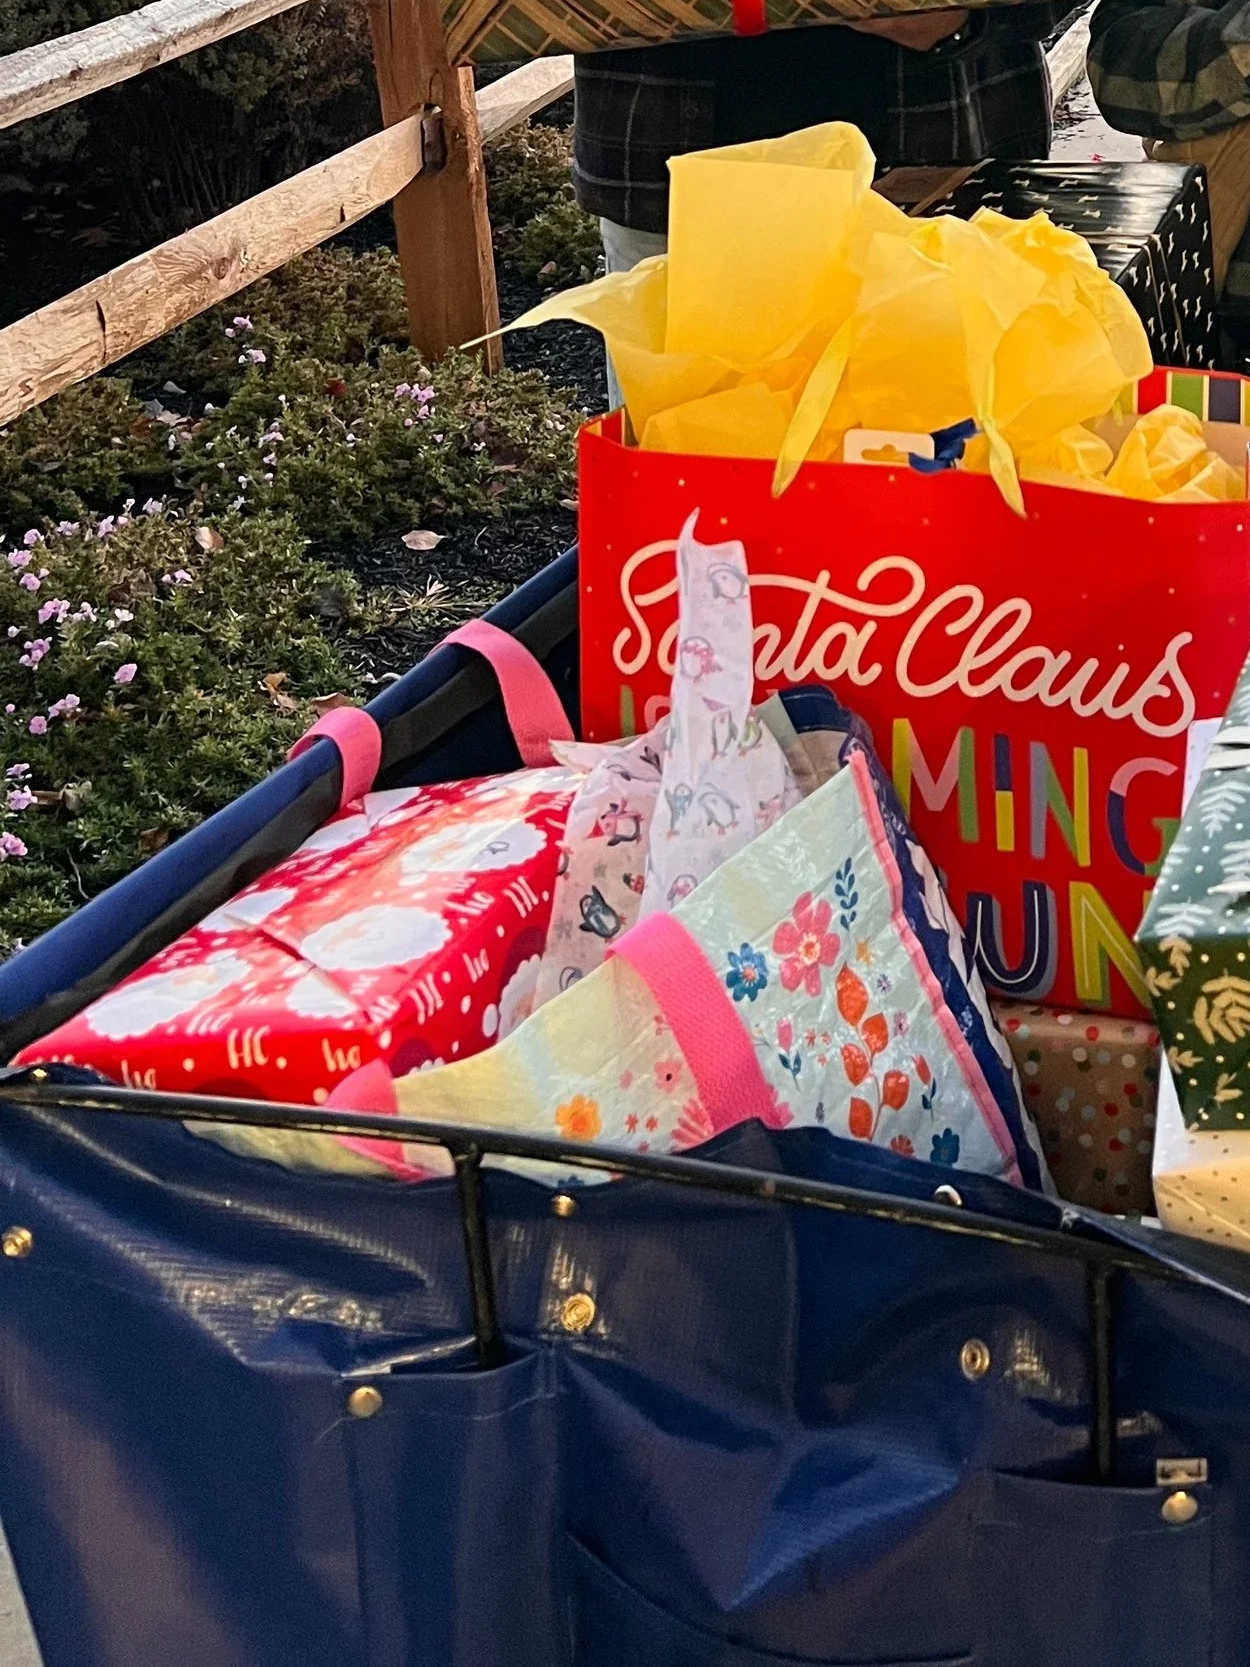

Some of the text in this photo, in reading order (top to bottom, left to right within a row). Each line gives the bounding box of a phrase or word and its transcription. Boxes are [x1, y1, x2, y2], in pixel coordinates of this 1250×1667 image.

[612, 538, 1196, 738] Snta Claus
[892, 718, 1182, 877] MING
